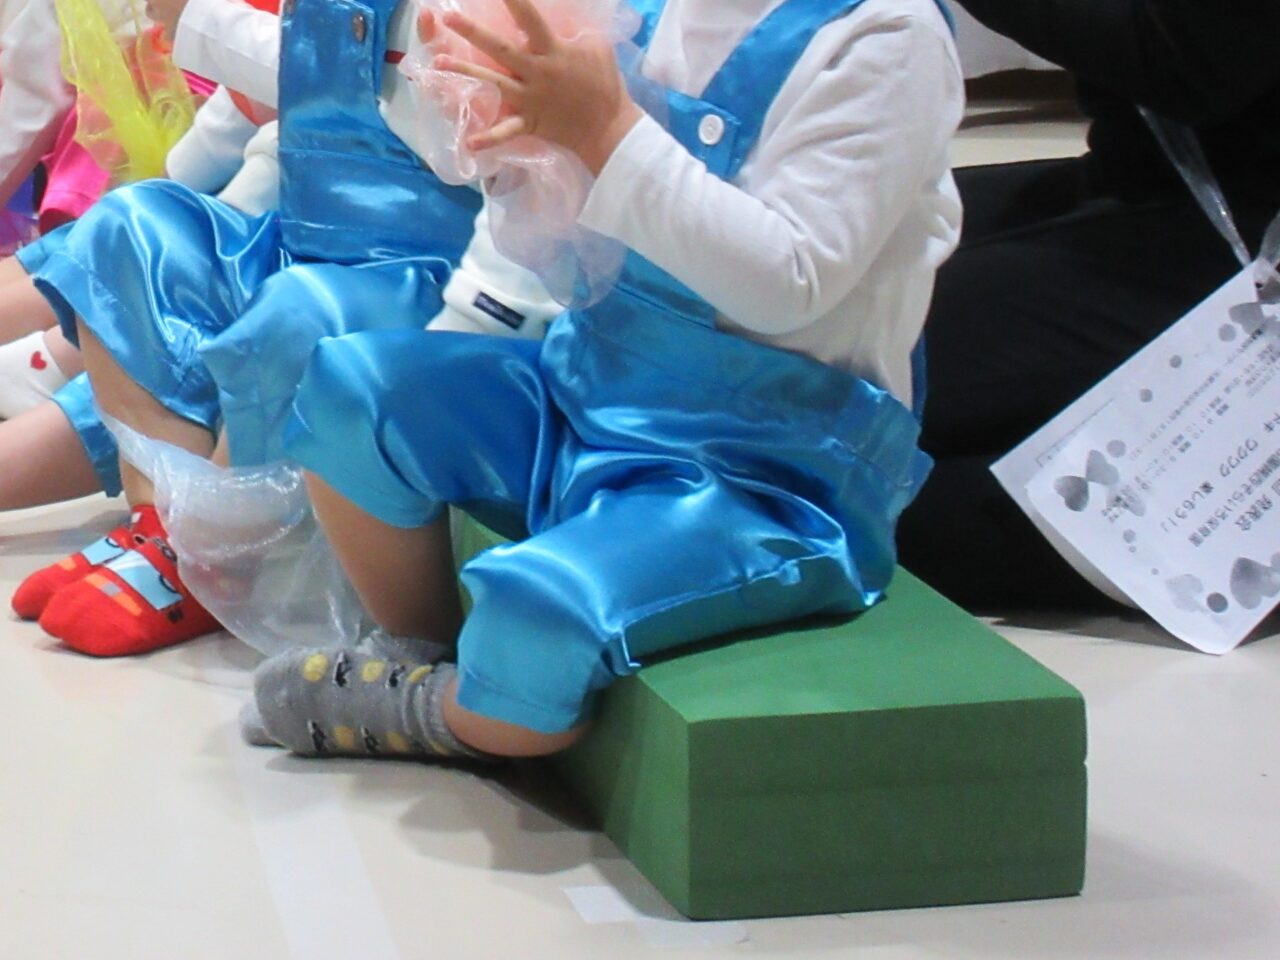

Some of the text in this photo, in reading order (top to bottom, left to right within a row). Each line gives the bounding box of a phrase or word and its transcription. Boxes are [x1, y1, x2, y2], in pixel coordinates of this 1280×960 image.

[1220, 438, 1259, 477] ワクワク
[1235, 493, 1273, 531] 発表会
